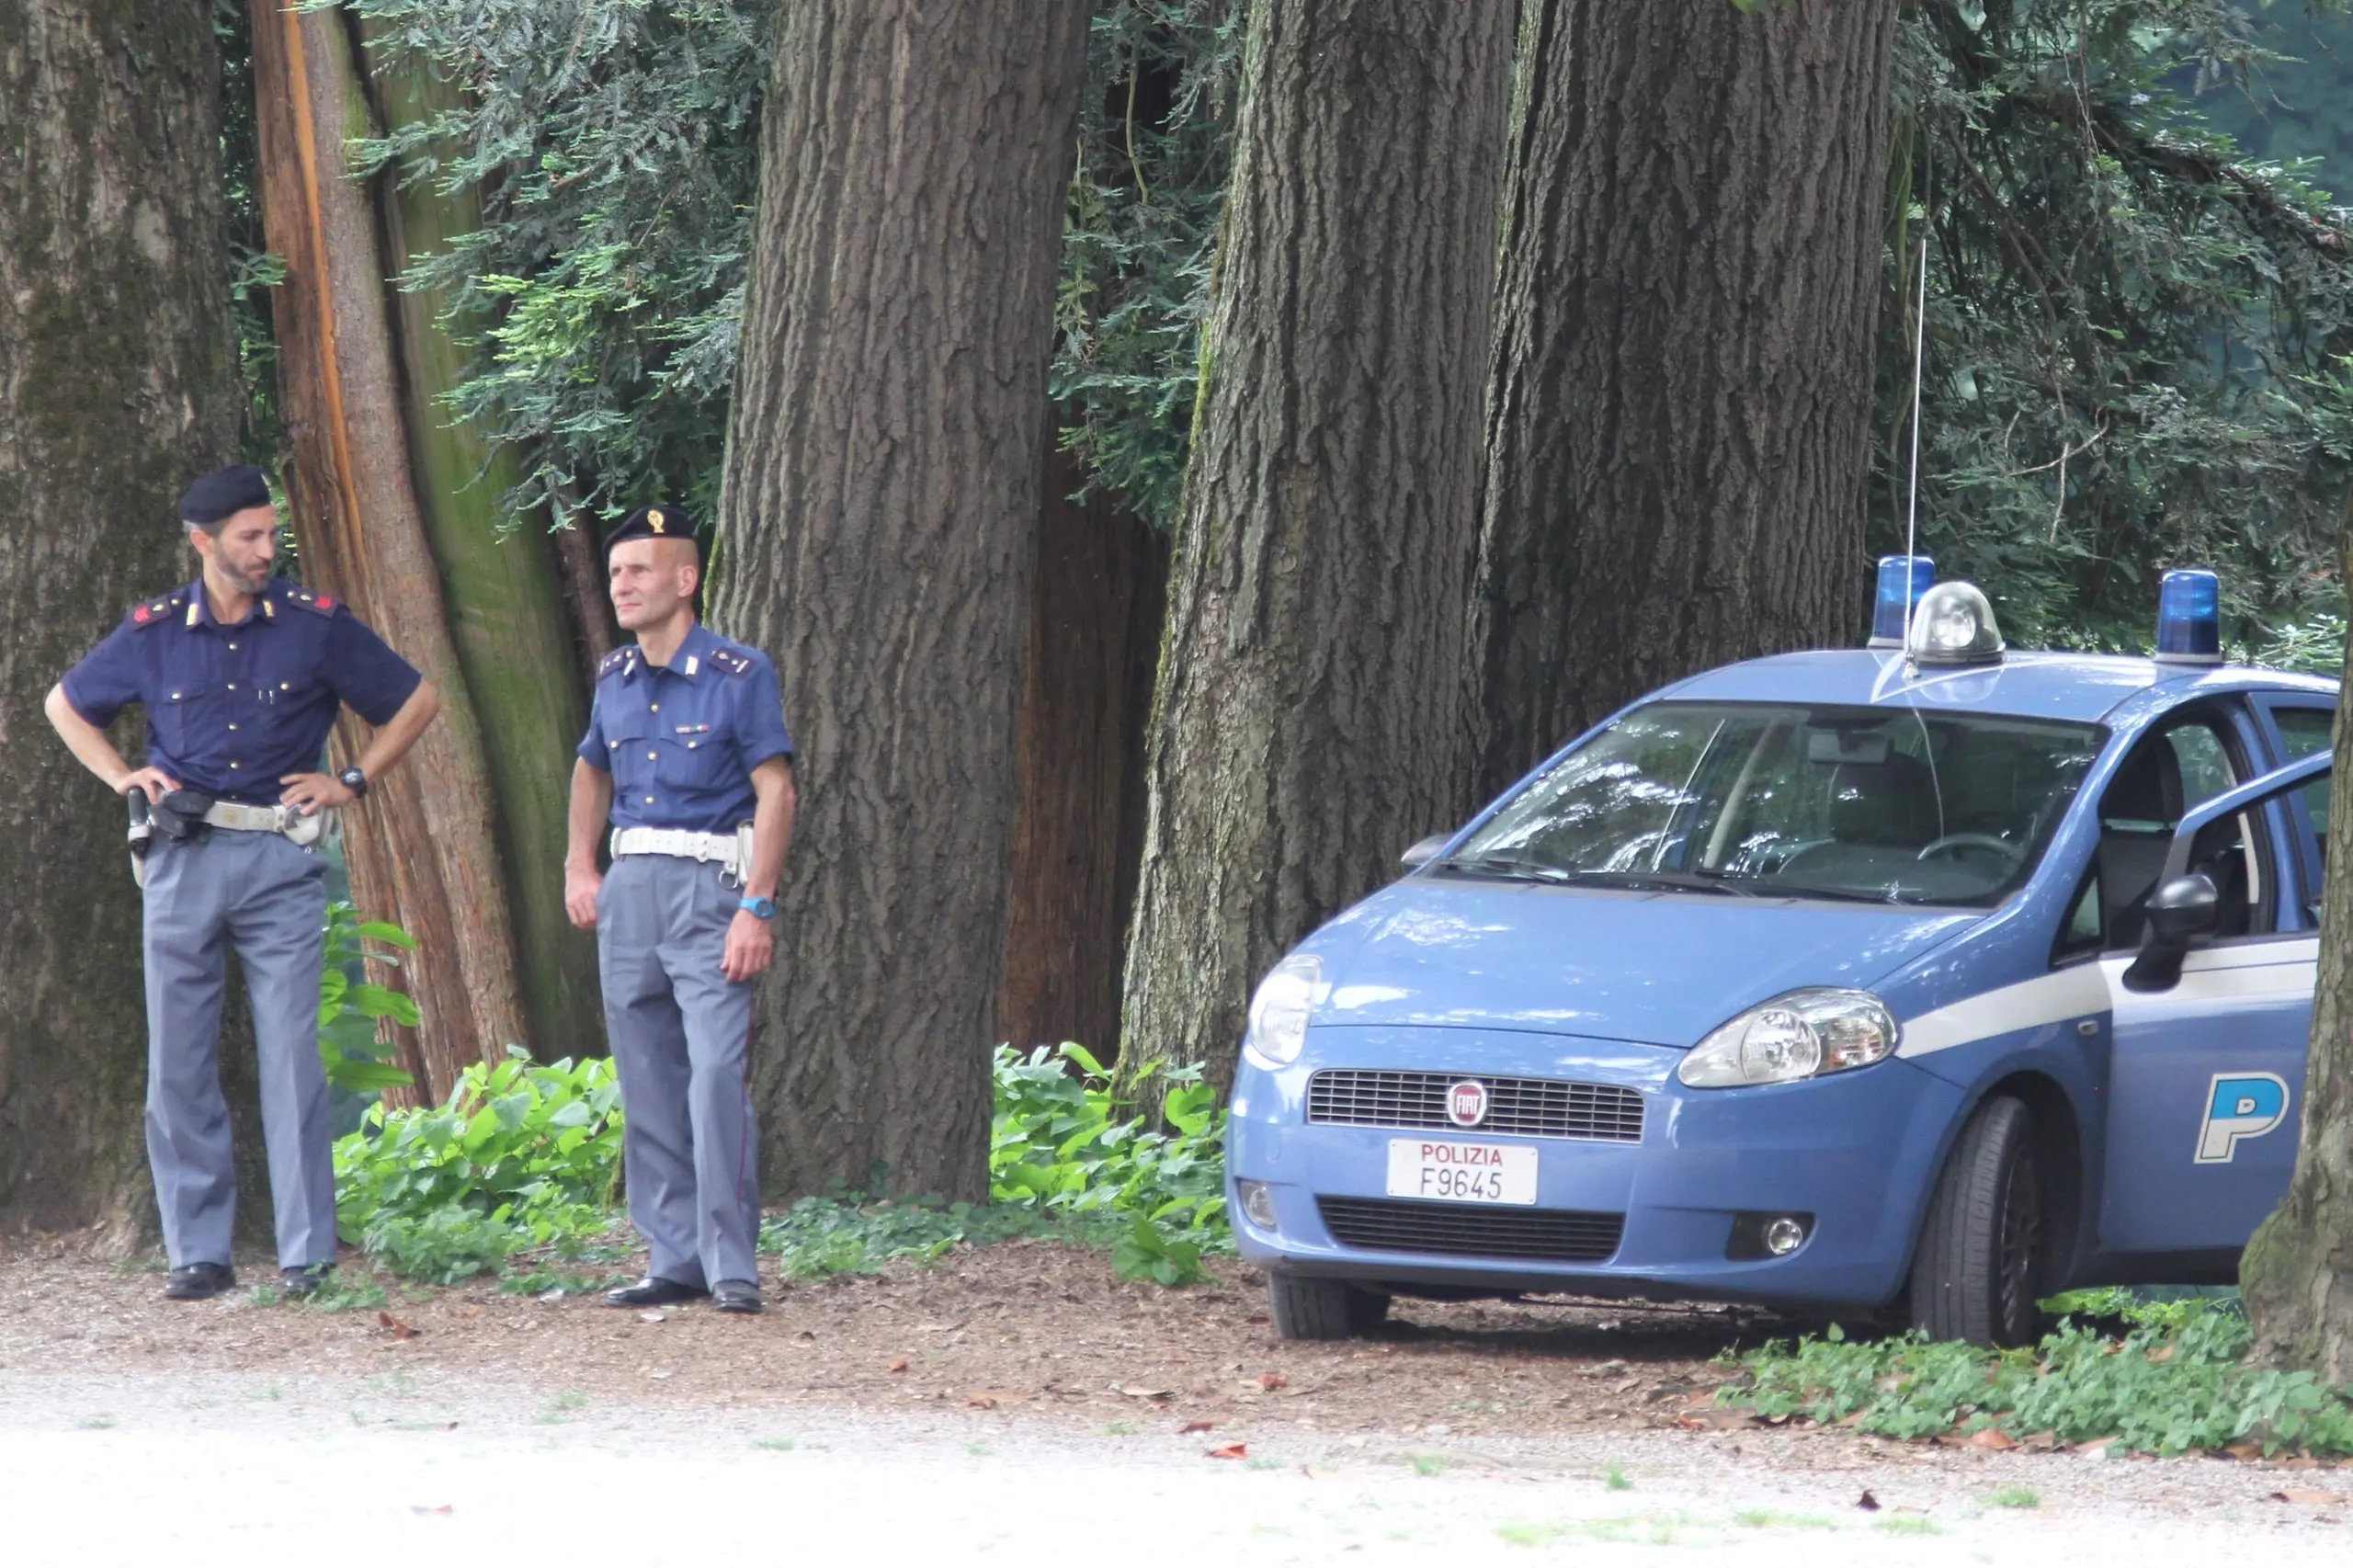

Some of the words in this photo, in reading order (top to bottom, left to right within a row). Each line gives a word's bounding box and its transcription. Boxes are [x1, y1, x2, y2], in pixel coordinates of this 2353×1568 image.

[1456, 1095, 1480, 1114] FIAT
[2194, 1072, 2290, 1164] P
[1422, 1143, 1503, 1166] POLIZIA
[1421, 1167, 1502, 1199] F9645
